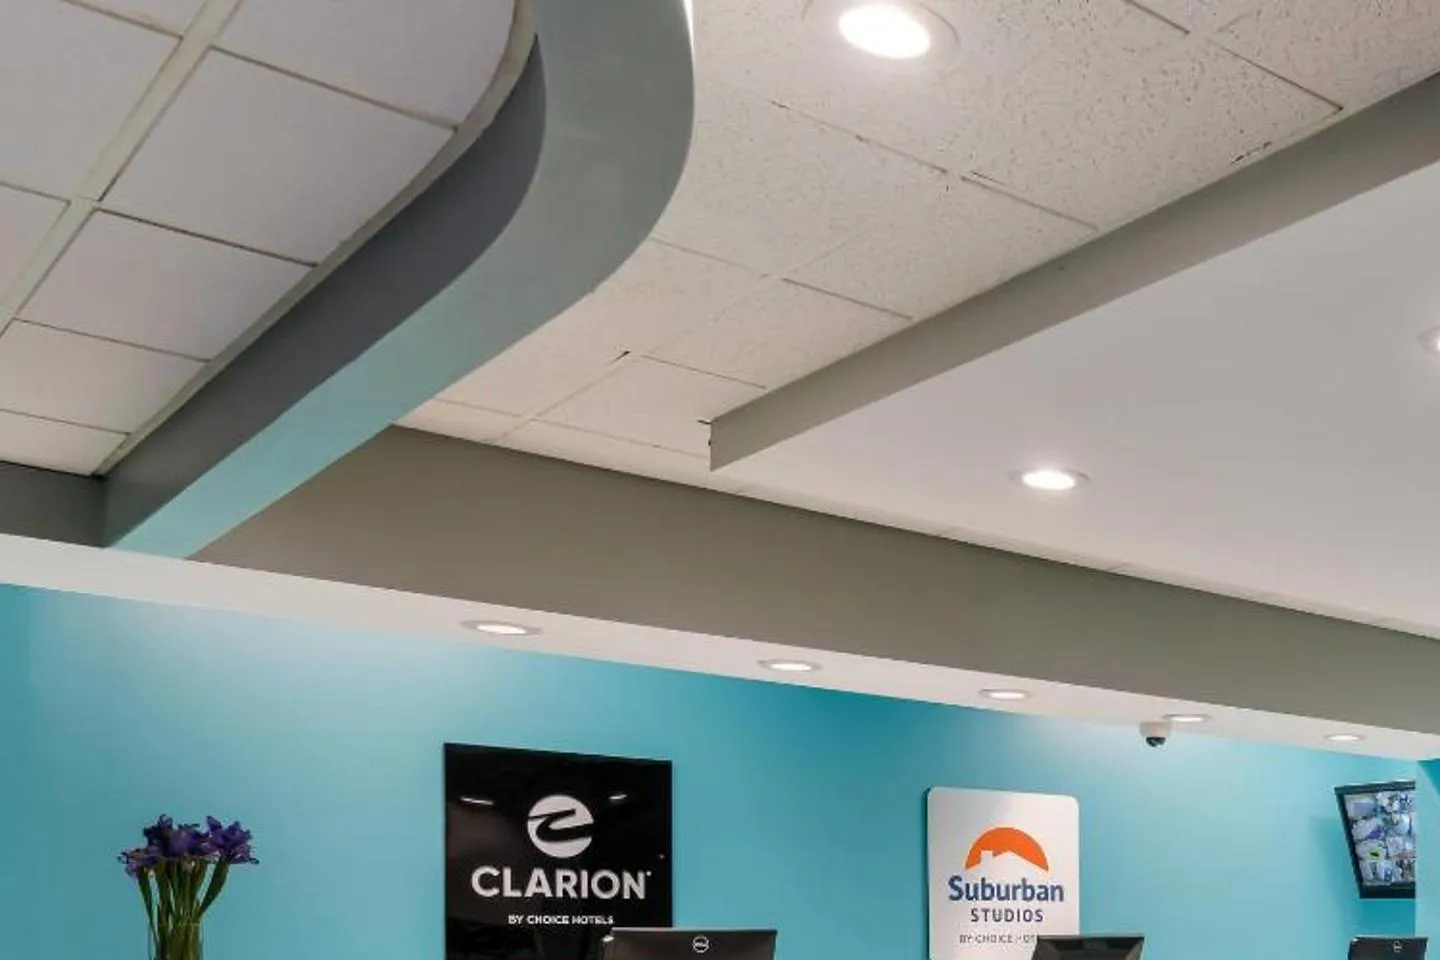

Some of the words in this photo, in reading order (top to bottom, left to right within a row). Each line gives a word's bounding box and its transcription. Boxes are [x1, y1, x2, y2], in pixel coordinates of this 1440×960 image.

[471, 865, 646, 900] CLARION
[948, 875, 1065, 902] Suburban
[508, 914, 524, 925] BY
[526, 914, 570, 925] CHOICE
[571, 914, 615, 925] HOTELS
[970, 907, 1044, 923] STUDIOS
[975, 933, 1013, 944] CHOICE
